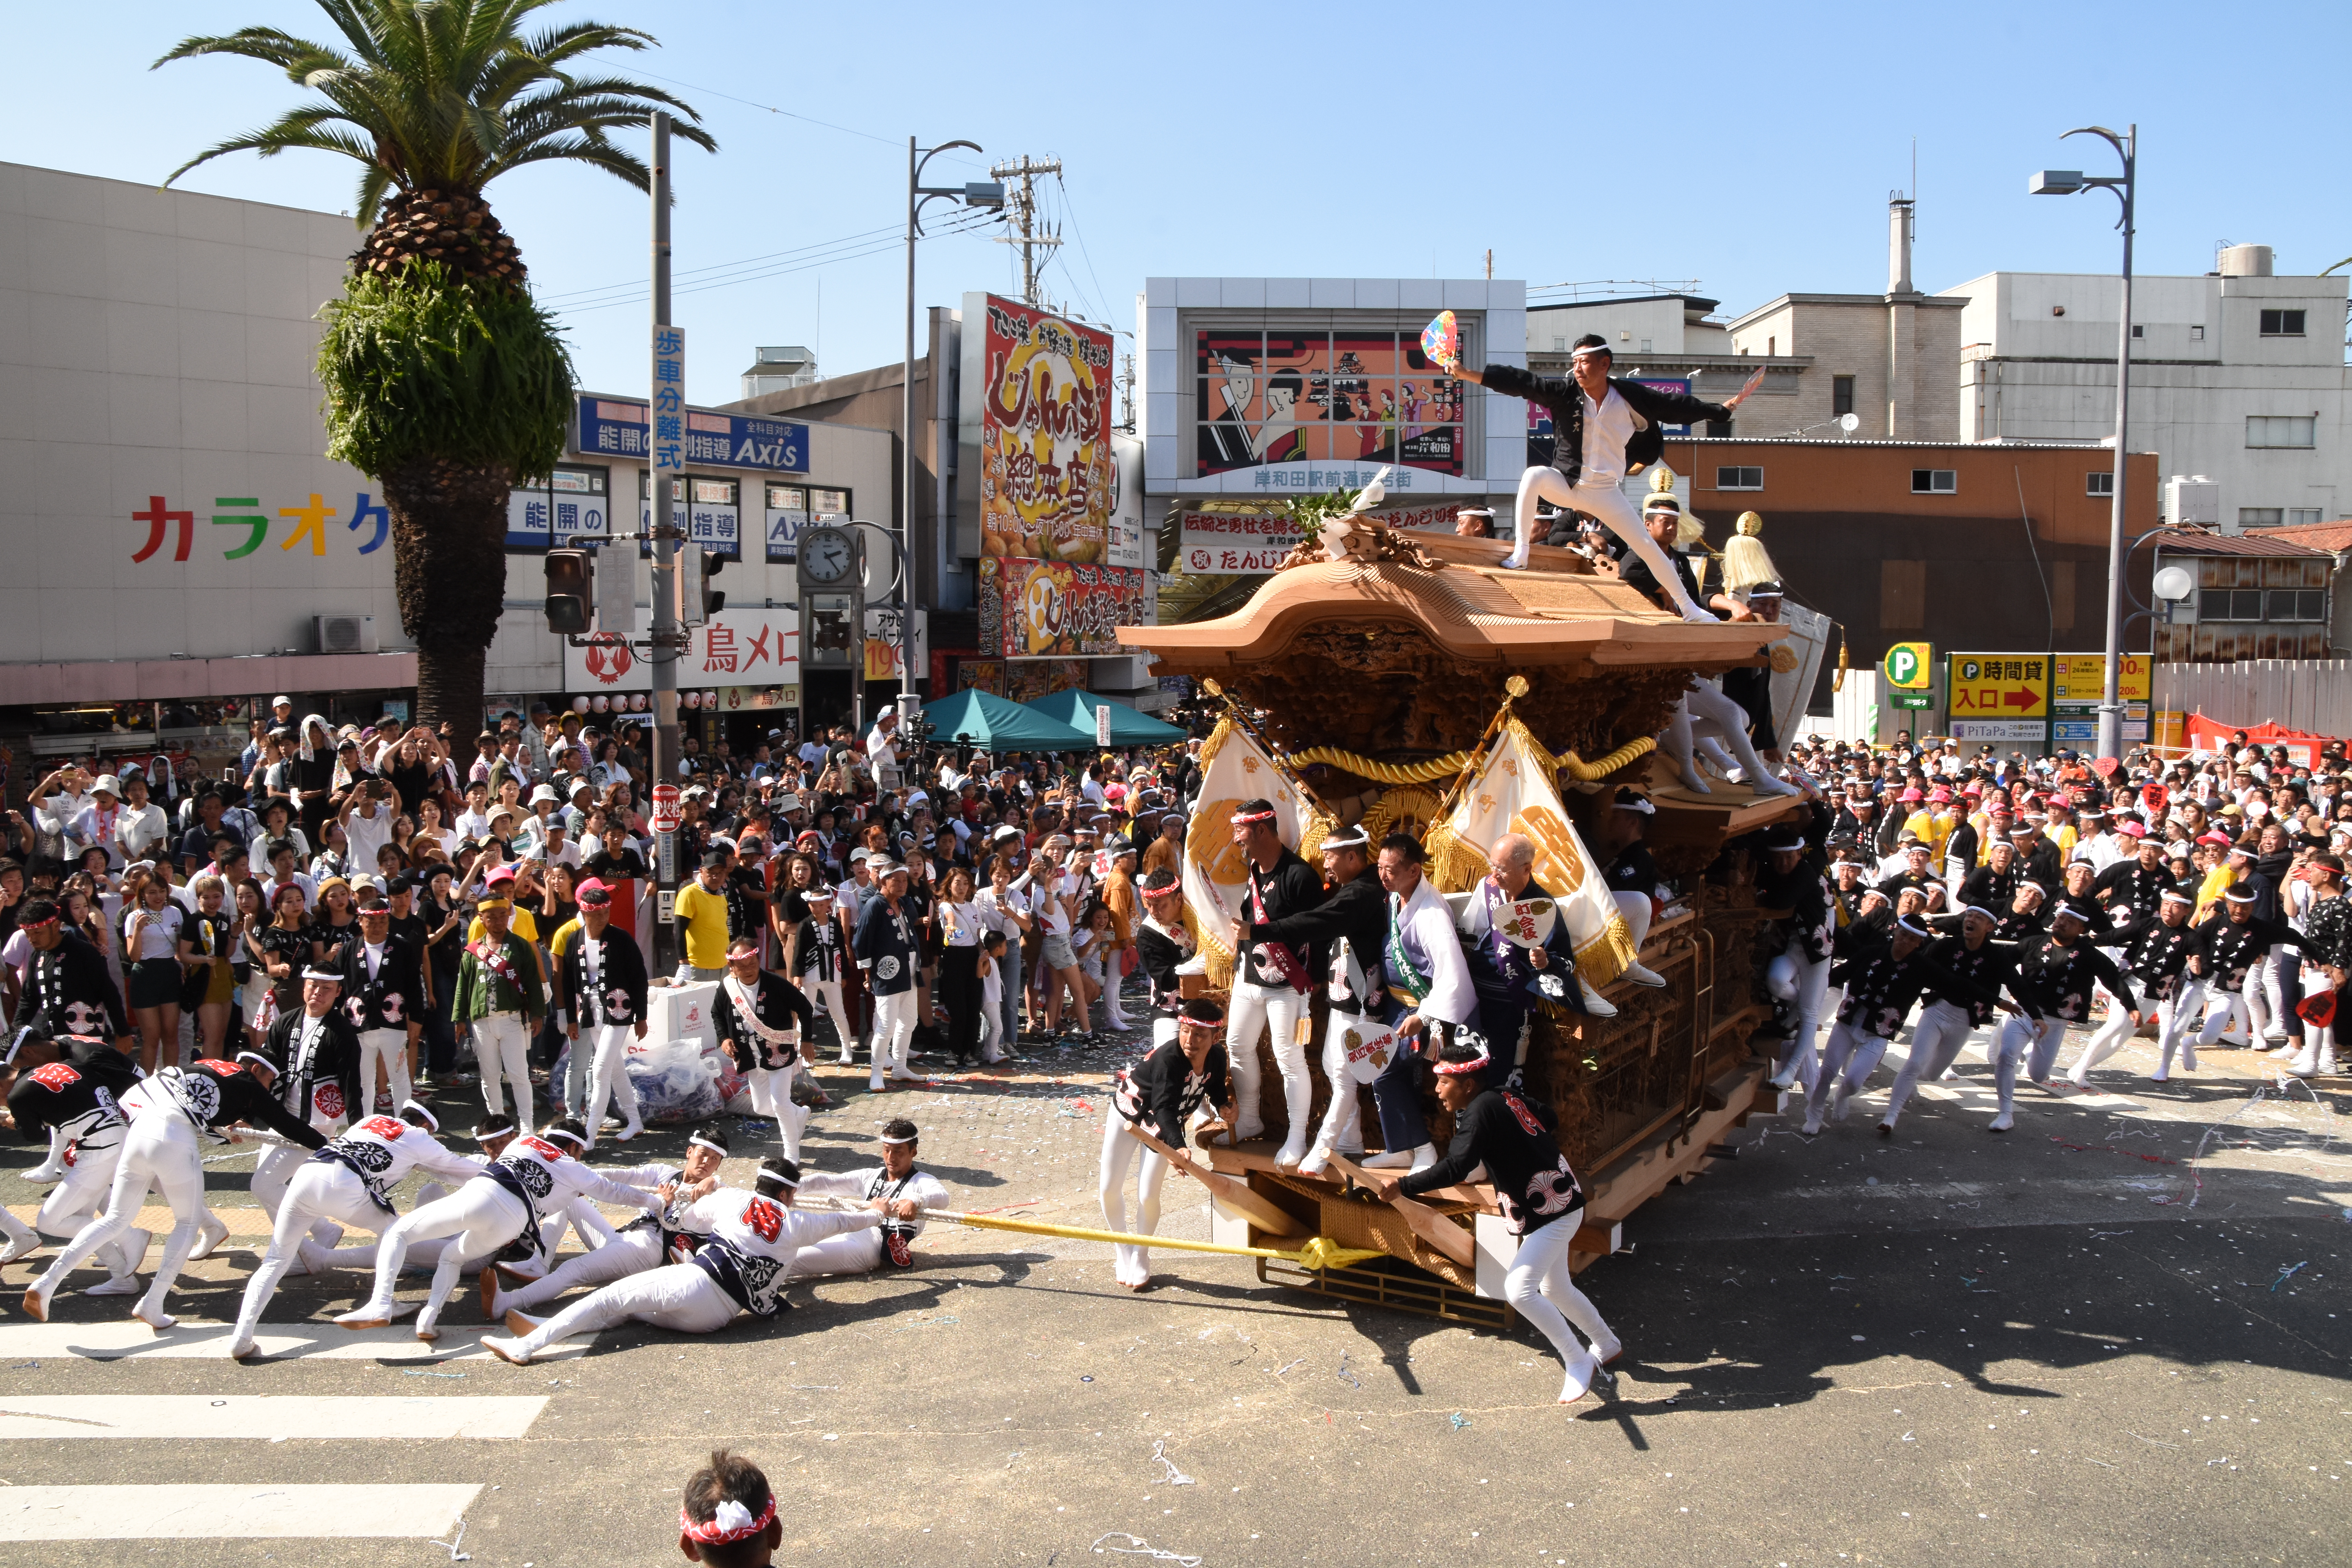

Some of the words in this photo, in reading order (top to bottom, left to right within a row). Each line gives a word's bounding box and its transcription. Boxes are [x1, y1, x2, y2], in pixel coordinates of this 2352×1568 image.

[988, 306, 1031, 345] たこ焼
[1038, 322, 1074, 357] お好み焼
[1078, 334, 1109, 368] 焼そば
[656, 330, 681, 469] 歩車分離式
[989, 352, 1107, 444] じゃんぼ
[746, 422, 793, 437] 全科目対応
[735, 438, 796, 466] Axis
[1419, 442, 1450, 452] 岸和田
[1255, 470, 1411, 488] 岸和田駅前通商店街
[772, 492, 800, 506] 受付中
[526, 501, 602, 530] 能開の
[643, 510, 735, 537] 別指導
[1073, 524, 1103, 542] 年中無休
[1194, 550, 1209, 568] 祝
[703, 622, 799, 673] 鳥メロ
[1896, 652, 1914, 680] P
[1967, 664, 1977, 677] P
[1984, 661, 2042, 681] 時間貸
[762, 689, 795, 705] 鳥メロ
[1956, 688, 1998, 709] 入口
[1968, 726, 2006, 736] PiTaPa
[653, 799, 680, 818] 消火栓
[1514, 902, 1538, 940] 町会長
[1490, 893, 1518, 980] 南会長
[304, 1025, 326, 1080] 南町青年団
